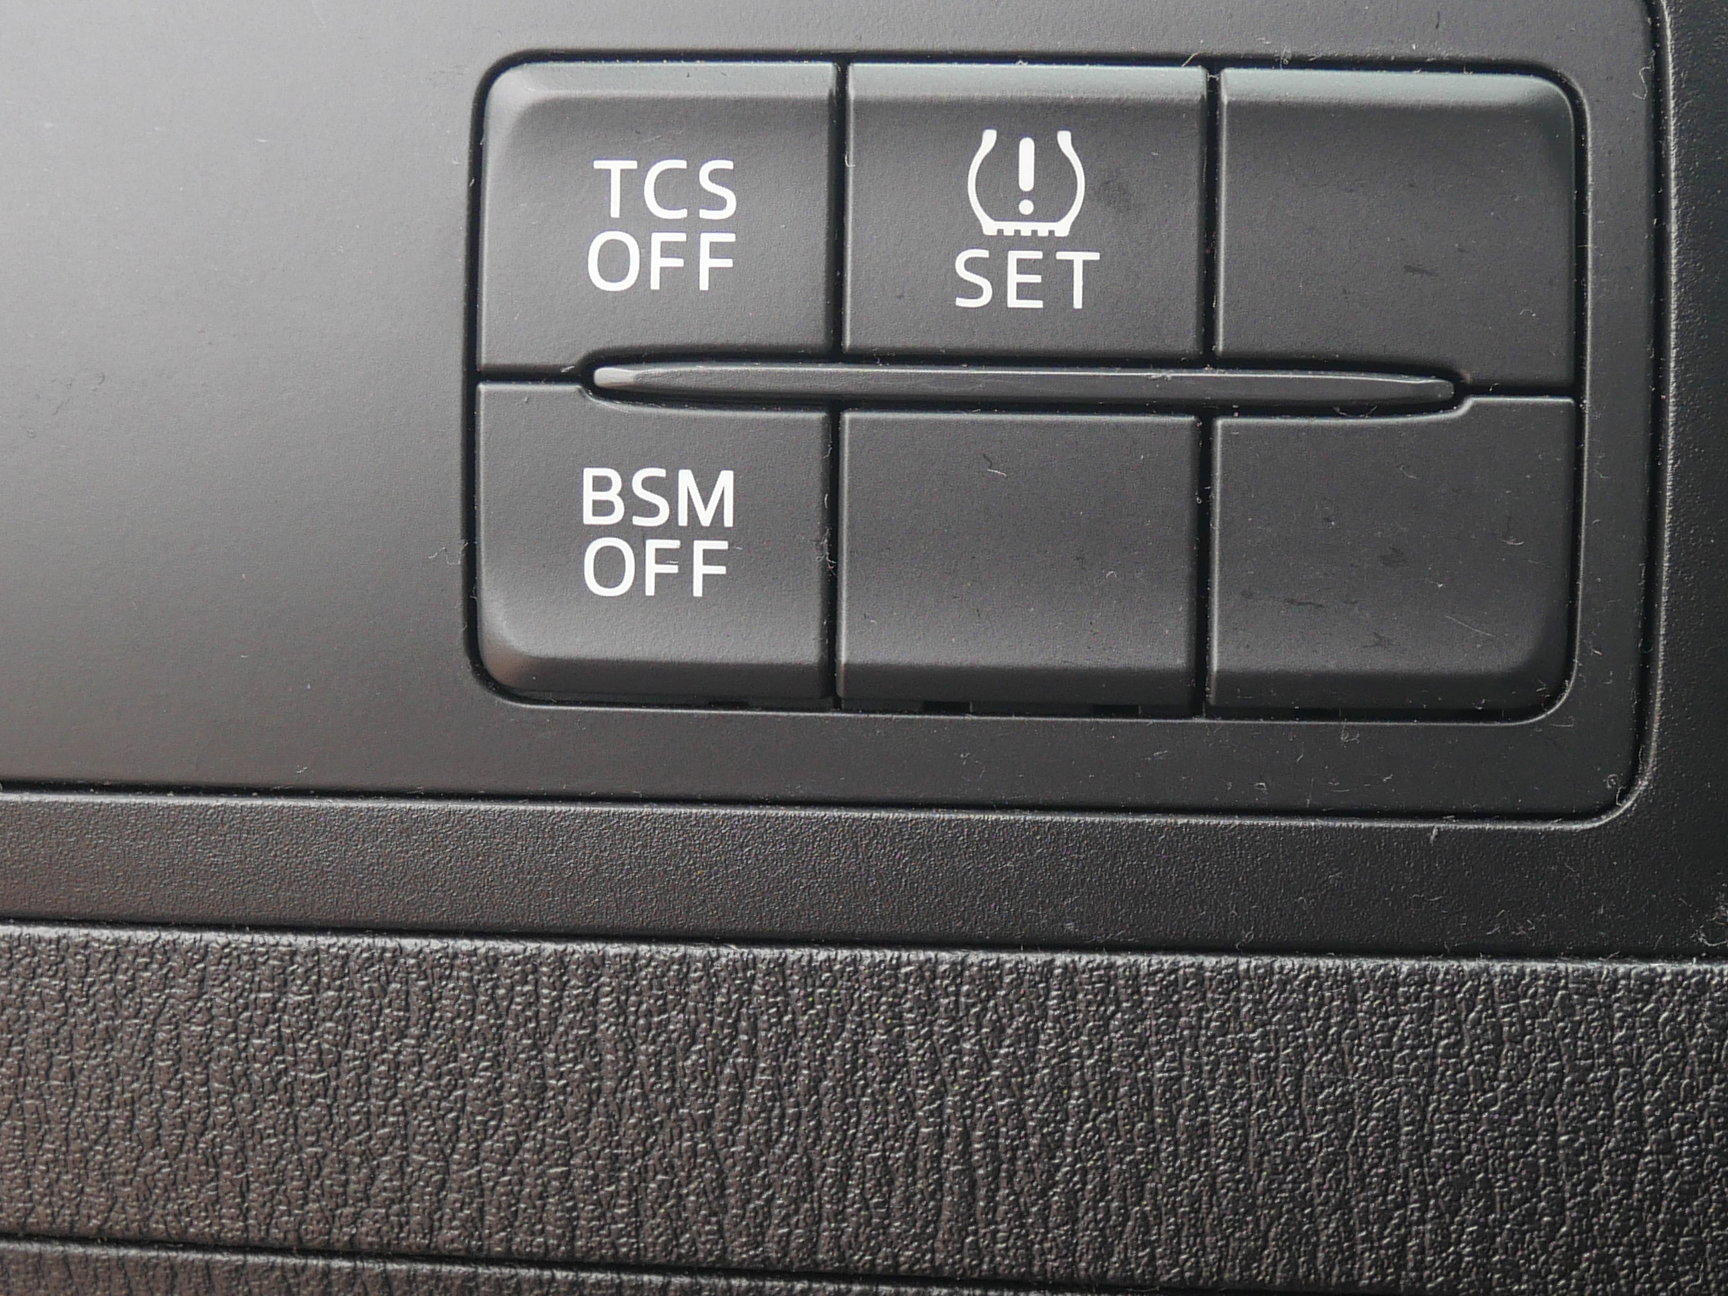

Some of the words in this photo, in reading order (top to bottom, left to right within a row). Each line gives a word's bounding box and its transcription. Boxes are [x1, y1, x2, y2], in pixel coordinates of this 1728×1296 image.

[592, 159, 738, 220] TCS
[587, 230, 737, 292] OFF
[954, 249, 1101, 309] SET
[581, 467, 736, 528] BSM
[582, 536, 730, 597] OFF
